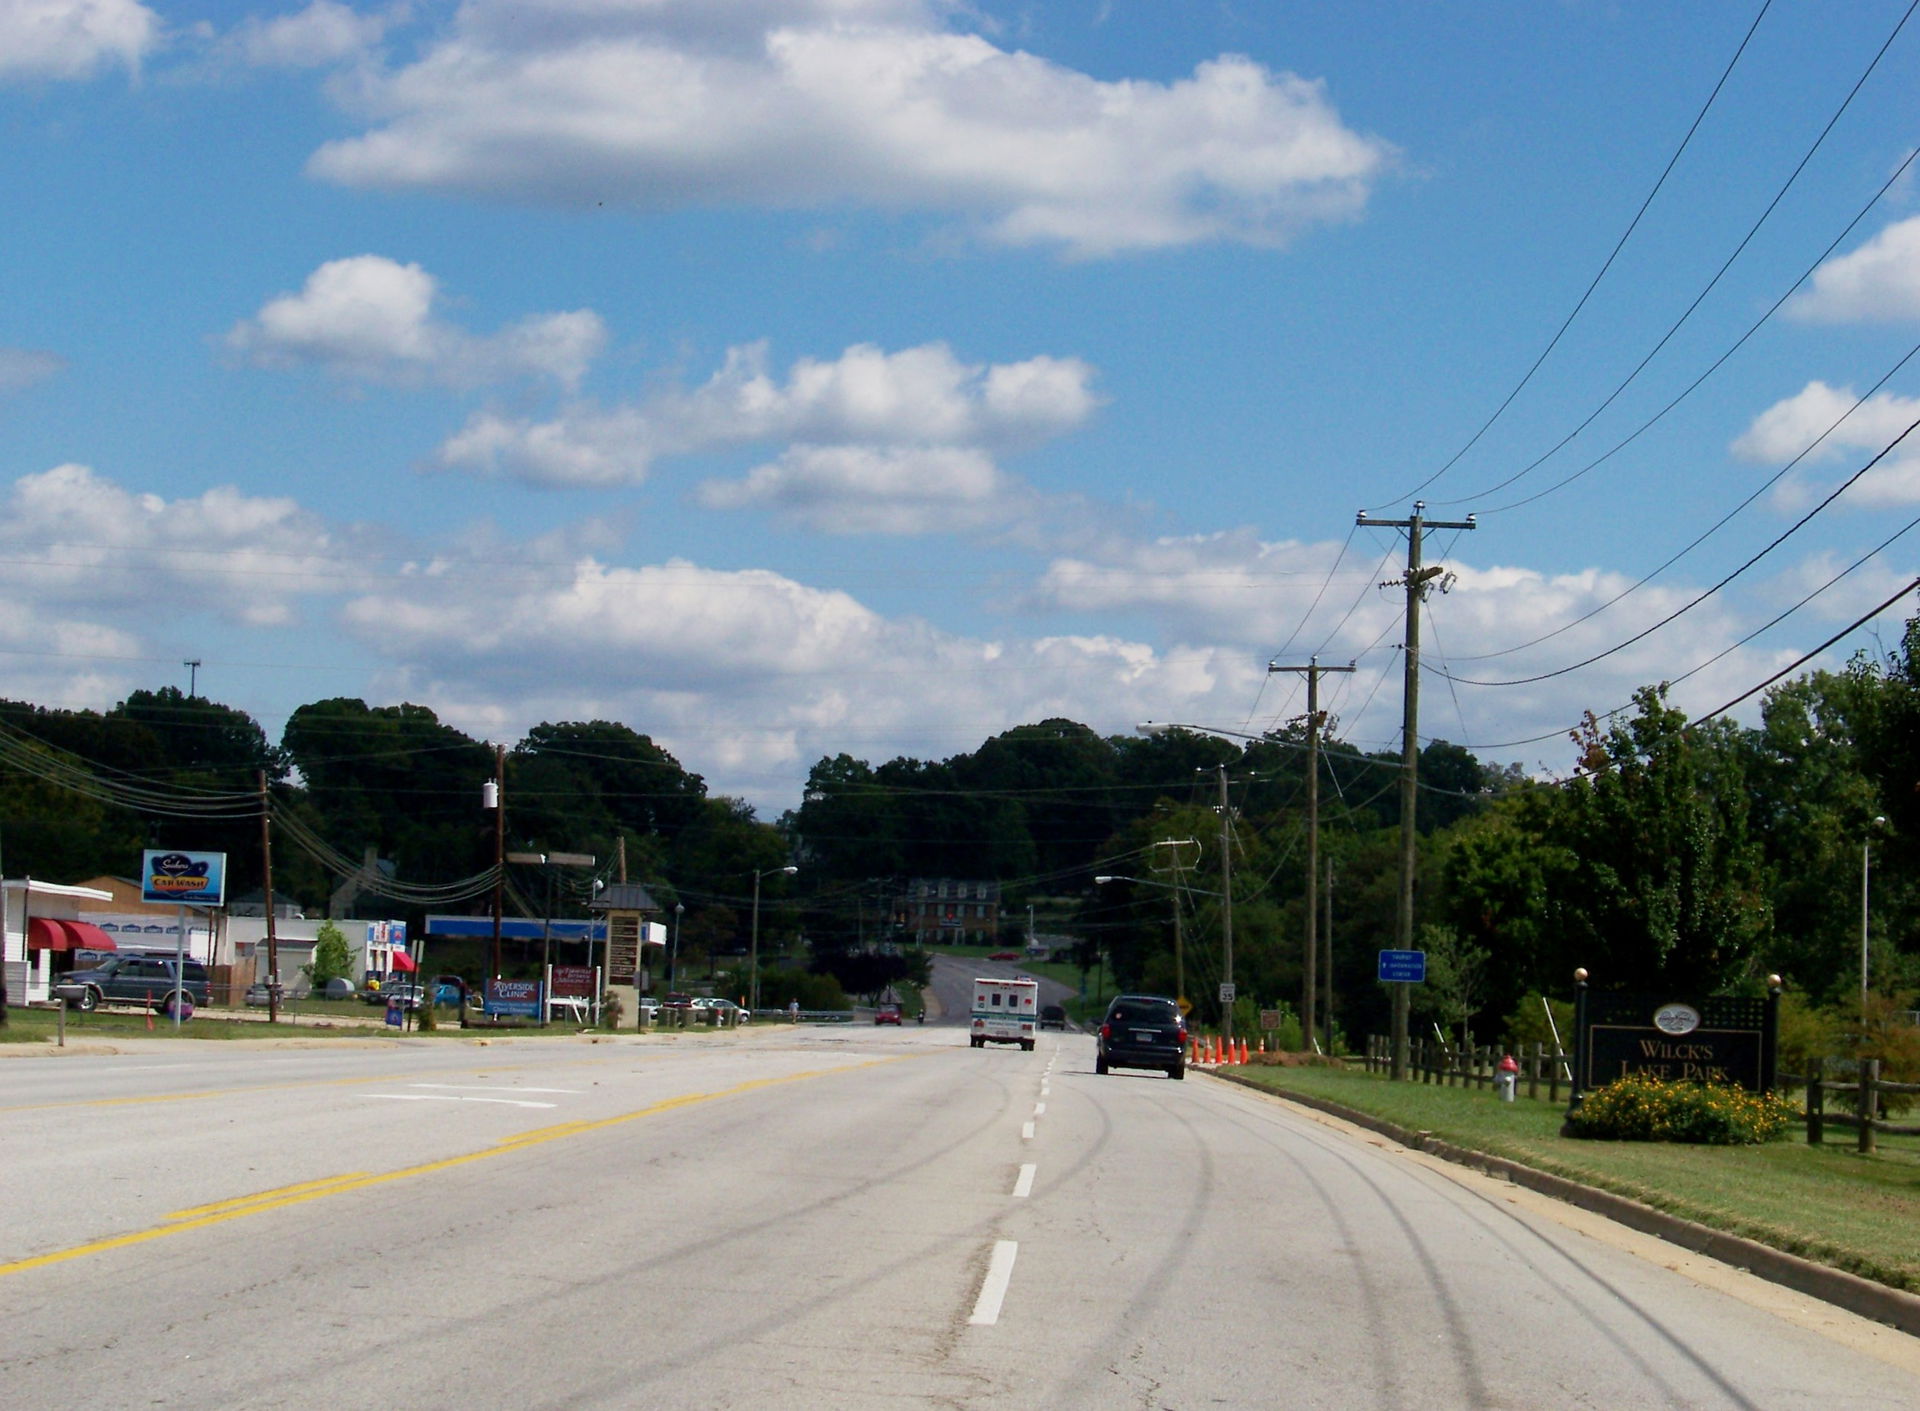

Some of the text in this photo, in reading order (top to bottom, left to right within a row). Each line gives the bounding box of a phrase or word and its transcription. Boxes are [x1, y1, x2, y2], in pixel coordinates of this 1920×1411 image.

[154, 878, 205, 888] CAR WASH
[499, 989, 528, 999] CLINIC
[1640, 1039, 1713, 1059] WILCK'S
[1683, 1062, 1730, 1081] PARK
